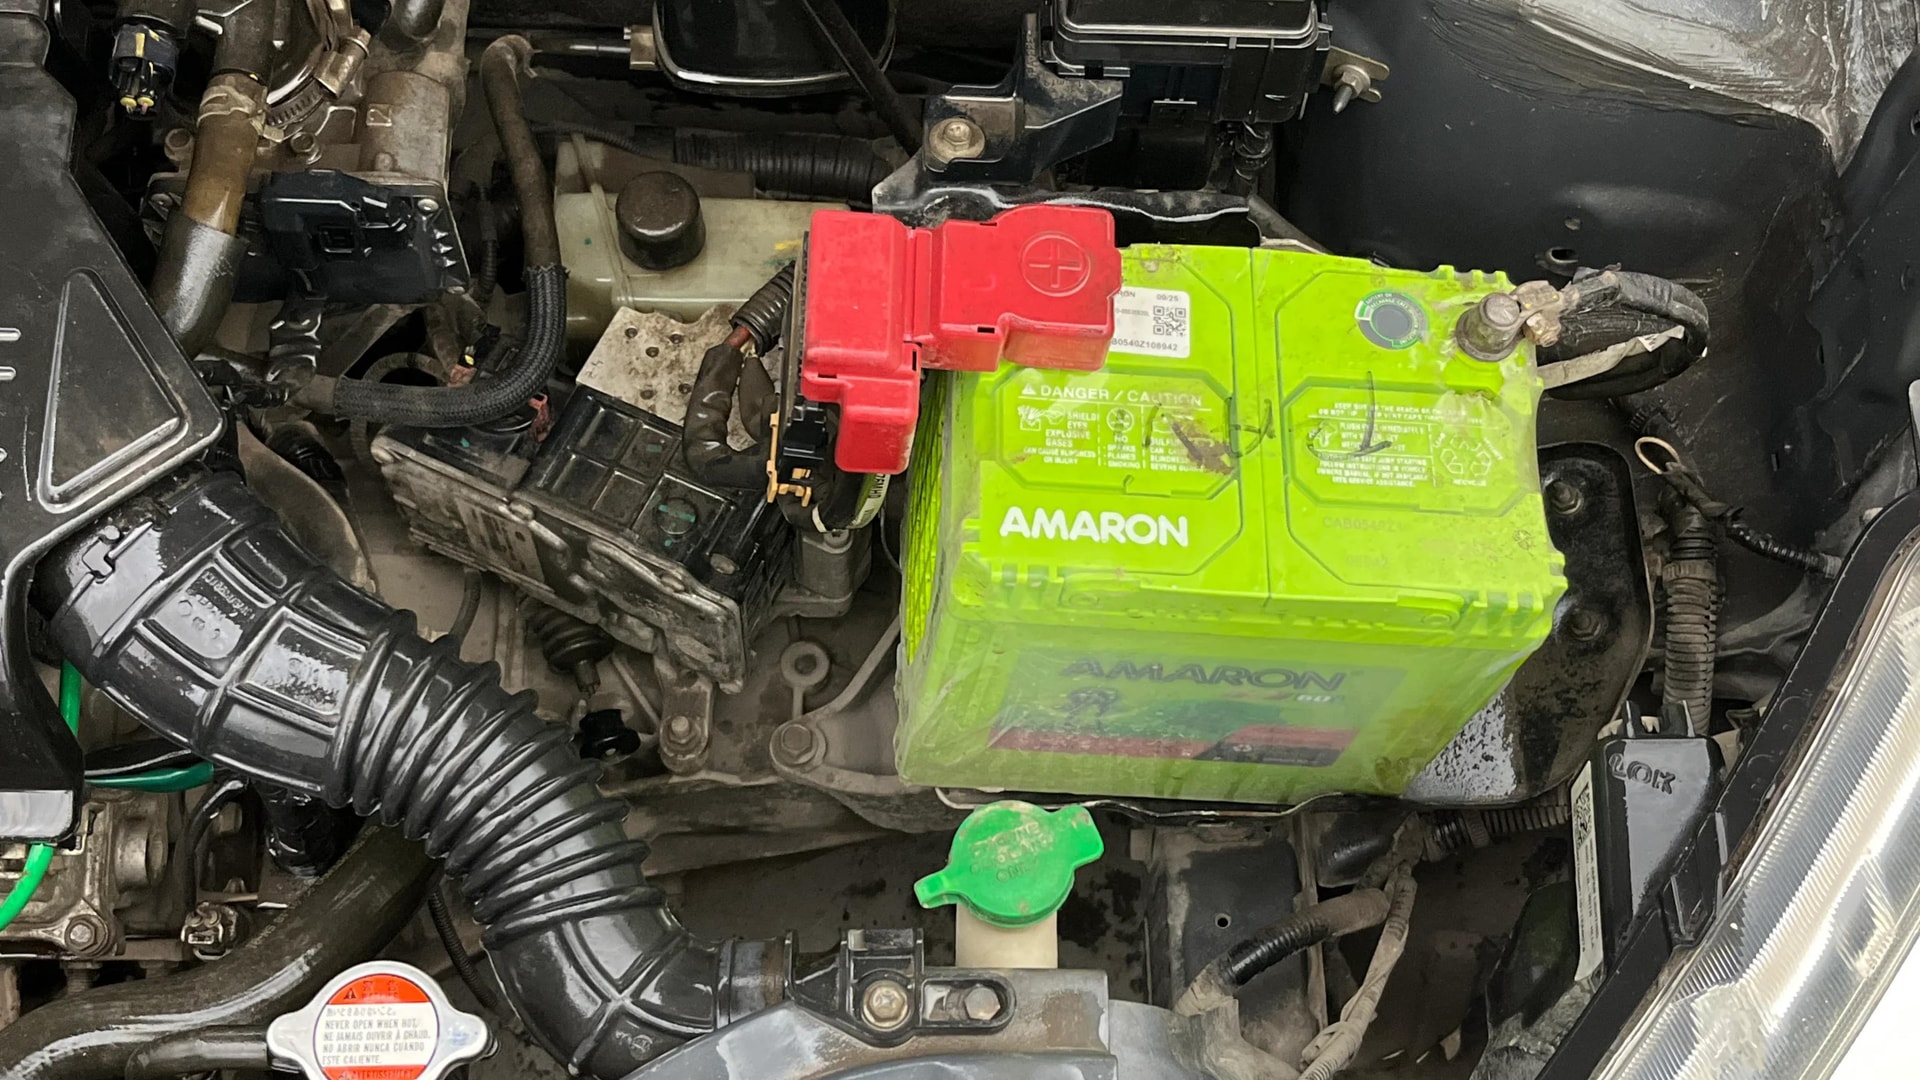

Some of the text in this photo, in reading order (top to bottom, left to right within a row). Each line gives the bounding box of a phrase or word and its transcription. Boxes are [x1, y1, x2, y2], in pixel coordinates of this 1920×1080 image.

[1040, 385, 1109, 400] DANGER
[1128, 390, 1202, 406] CAUTION
[1045, 429, 1091, 440] EXPLOSIVE
[1000, 505, 1189, 548] AMARON
[1060, 657, 1347, 692] AMARON
[324, 1020, 350, 1030] NEVER
[352, 1019, 373, 1030] OPEN
[376, 1018, 398, 1029] WHEN
[324, 1032, 334, 1042] NE
[336, 1031, 364, 1042] JAMAIS
[366, 1030, 392, 1041] OUVRIR
[322, 1042, 425, 1054] NO ABRIR NUNCA CUANDO
[322, 1055, 340, 1066] ESTE
